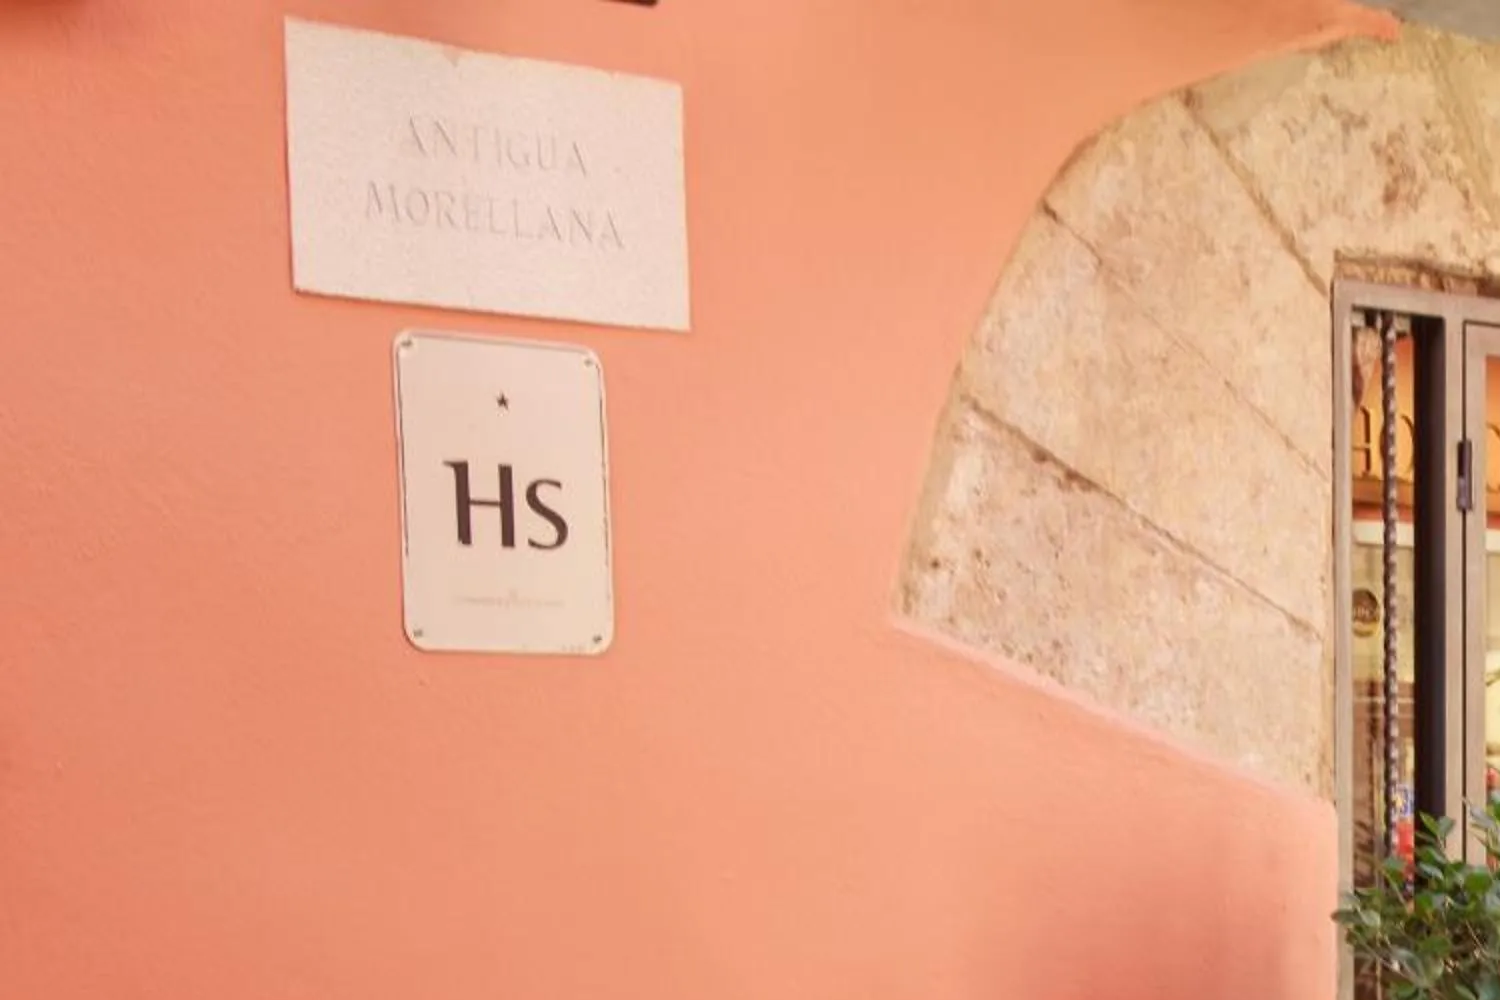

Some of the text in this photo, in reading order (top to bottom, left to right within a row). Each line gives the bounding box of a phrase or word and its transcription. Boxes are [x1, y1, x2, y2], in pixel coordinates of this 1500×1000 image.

[400, 114, 589, 179] ANTIGUA
[364, 179, 626, 251] MORELLANA
[442, 459, 569, 551] HS
